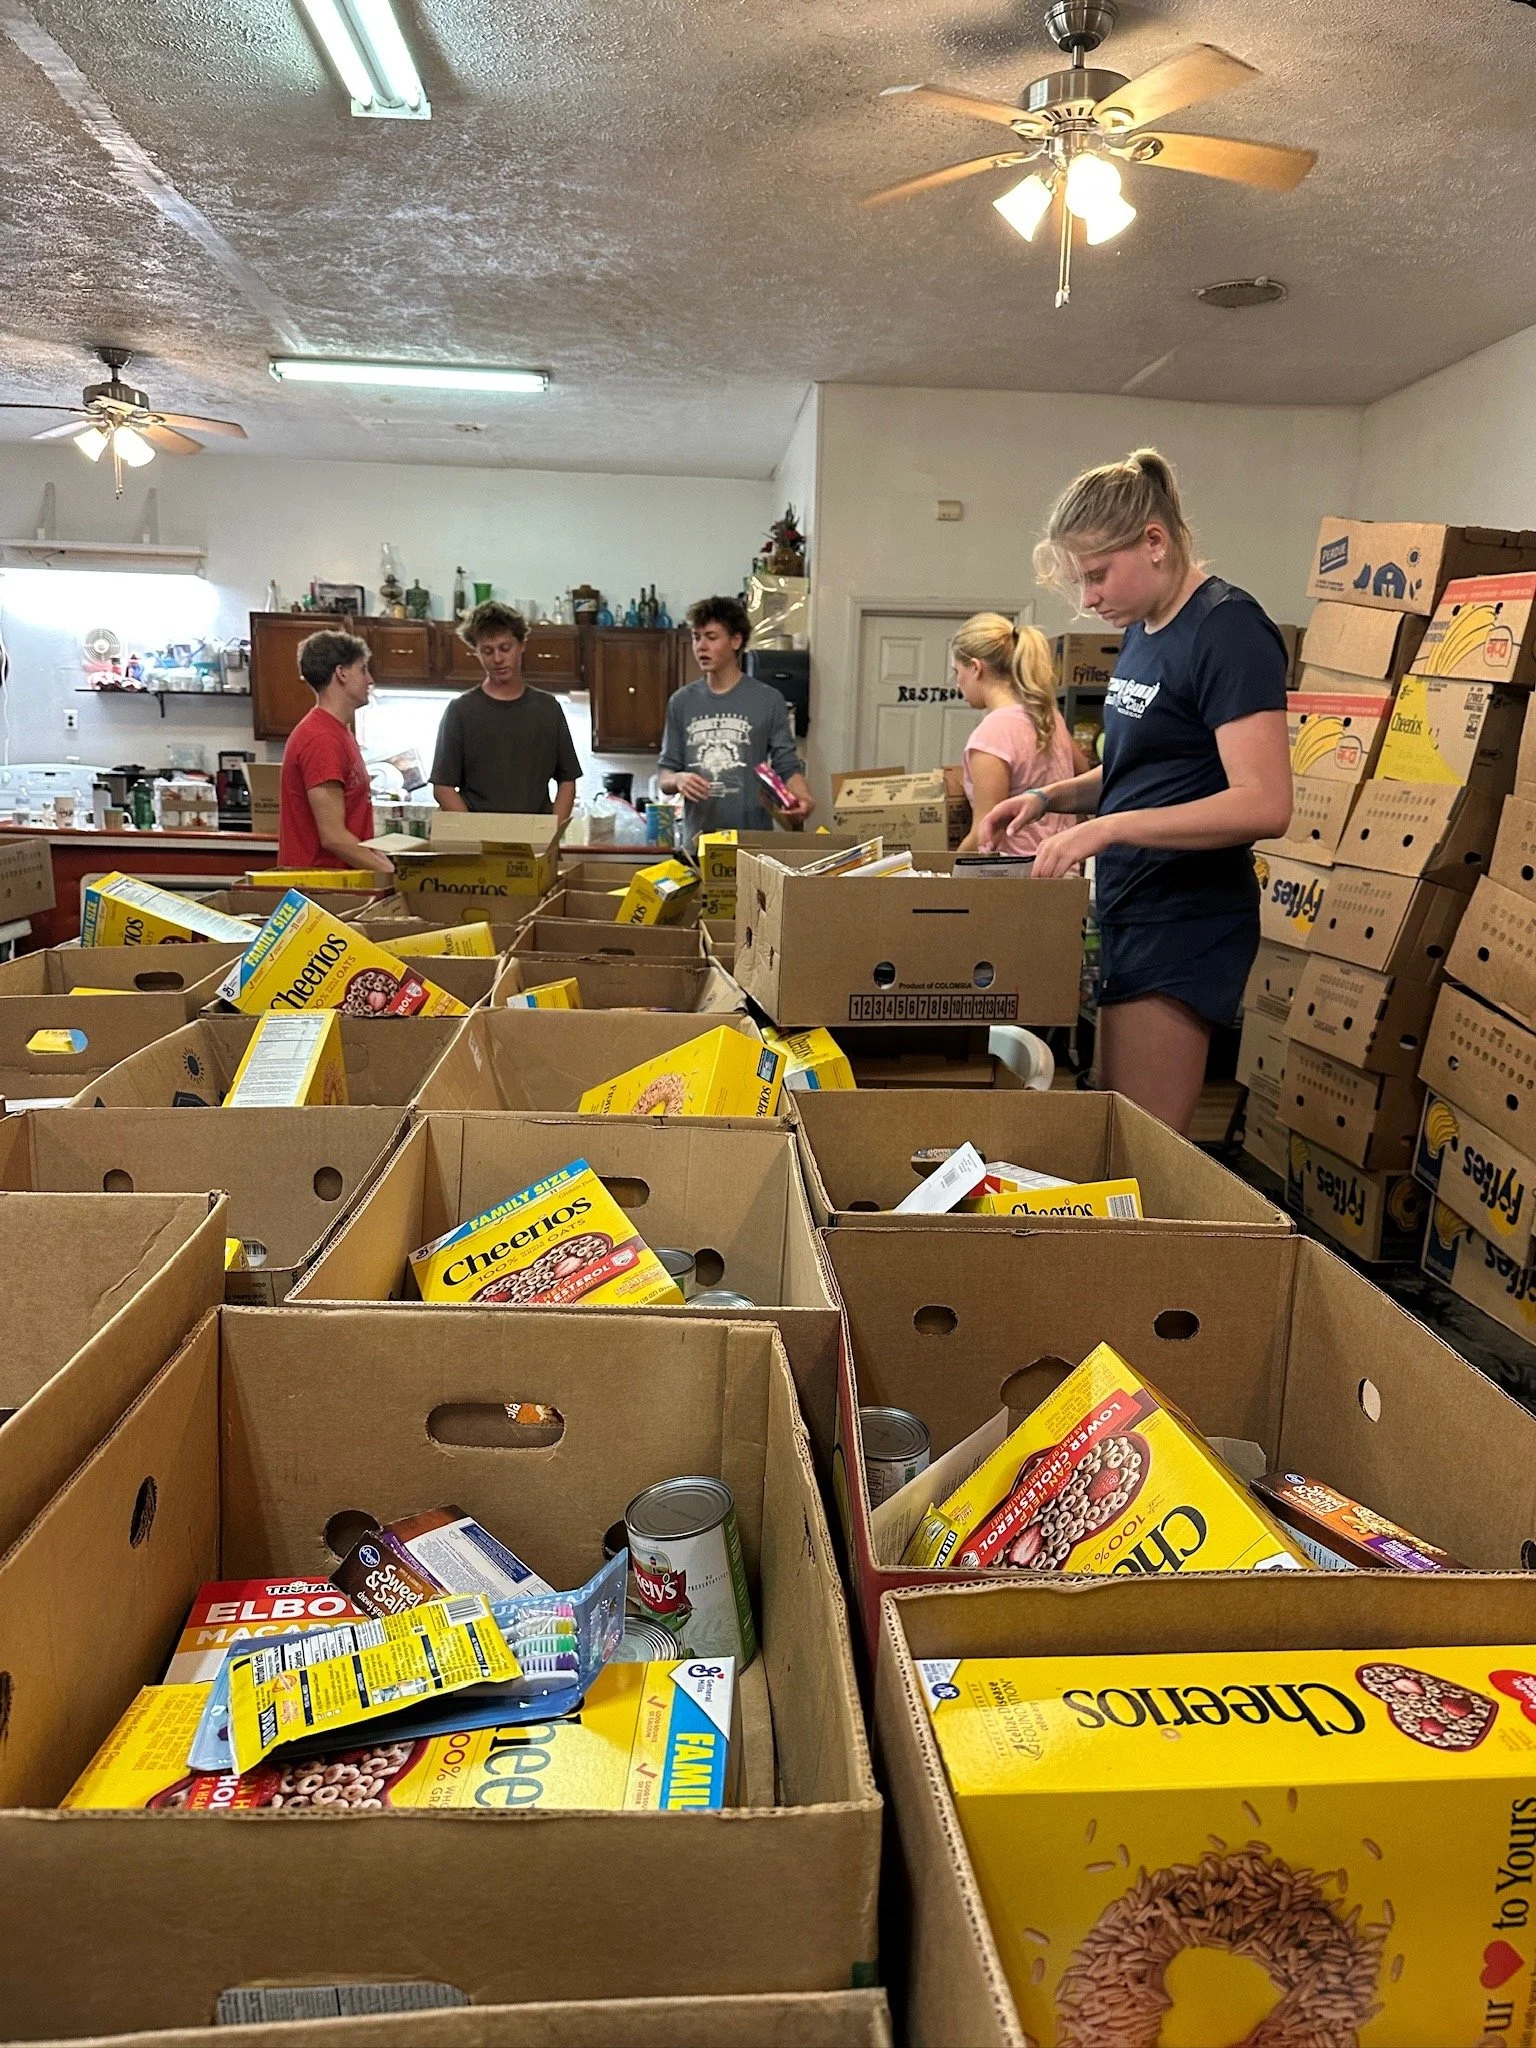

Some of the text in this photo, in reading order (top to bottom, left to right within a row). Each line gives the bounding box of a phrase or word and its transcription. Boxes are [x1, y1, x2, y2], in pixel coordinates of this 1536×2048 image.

[898, 686, 964, 703] RESTROO
[244, 902, 297, 967] FAMILY SIZE
[270, 933, 348, 1010] Cheerios
[899, 982, 925, 990] Product
[926, 982, 934, 990] of
[469, 1170, 571, 1231] FAMILY SIZE
[443, 1197, 592, 1287] Cheerios
[547, 1219, 586, 1242] OATS
[476, 1256, 518, 1283] 100%
[551, 1265, 610, 1302] ESTEROL
[1059, 1435, 1075, 1451] PART
[1069, 1402, 1122, 1451] LOWER
[1074, 1425, 1083, 1436] AS
[1019, 1461, 1073, 1523] CAN HELP
[1028, 1466, 1046, 1487] HEART
[979, 1451, 1070, 1551] CHOLESTEROL
[1004, 1486, 1028, 1513] HEALTHY
[991, 1511, 1006, 1529] DIET
[1095, 1513, 1146, 1564] 100%
[942, 1531, 957, 1553] OLD
[356, 1591, 375, 1612] chewy
[365, 1570, 380, 1591] &
[373, 1584, 409, 1614] Salt
[377, 1564, 424, 1609] Sweet
[696, 1679, 706, 1693] Mills
[704, 1679, 715, 1703] General
[988, 1681, 1024, 1743] Celiac Disease
[1062, 1683, 1366, 1738] Cheerios
[436, 1733, 471, 1781] 00%
[667, 1733, 715, 1810] FAMIL
[208, 1775, 240, 1809] HOL
[1495, 1797, 1536, 1894] Yours
[1491, 1898, 1529, 1930] to
